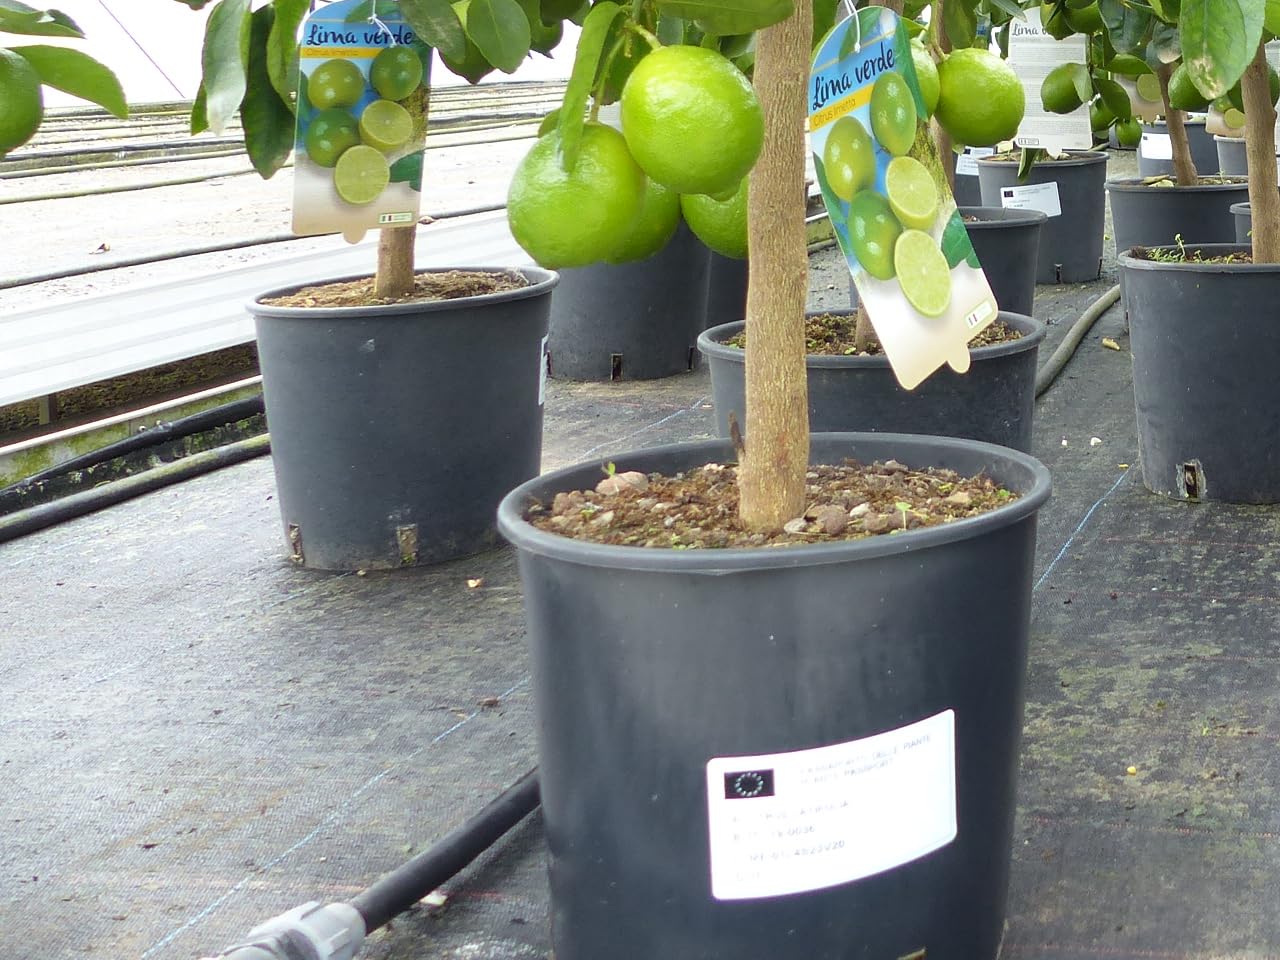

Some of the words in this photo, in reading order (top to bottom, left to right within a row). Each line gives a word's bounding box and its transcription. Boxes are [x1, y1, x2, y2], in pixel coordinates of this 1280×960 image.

[306, 23, 358, 46] Lima
[364, 24, 414, 45] verde
[812, 72, 853, 111] Lima
[854, 40, 896, 84] verde
[813, 110, 834, 127] Citrus
